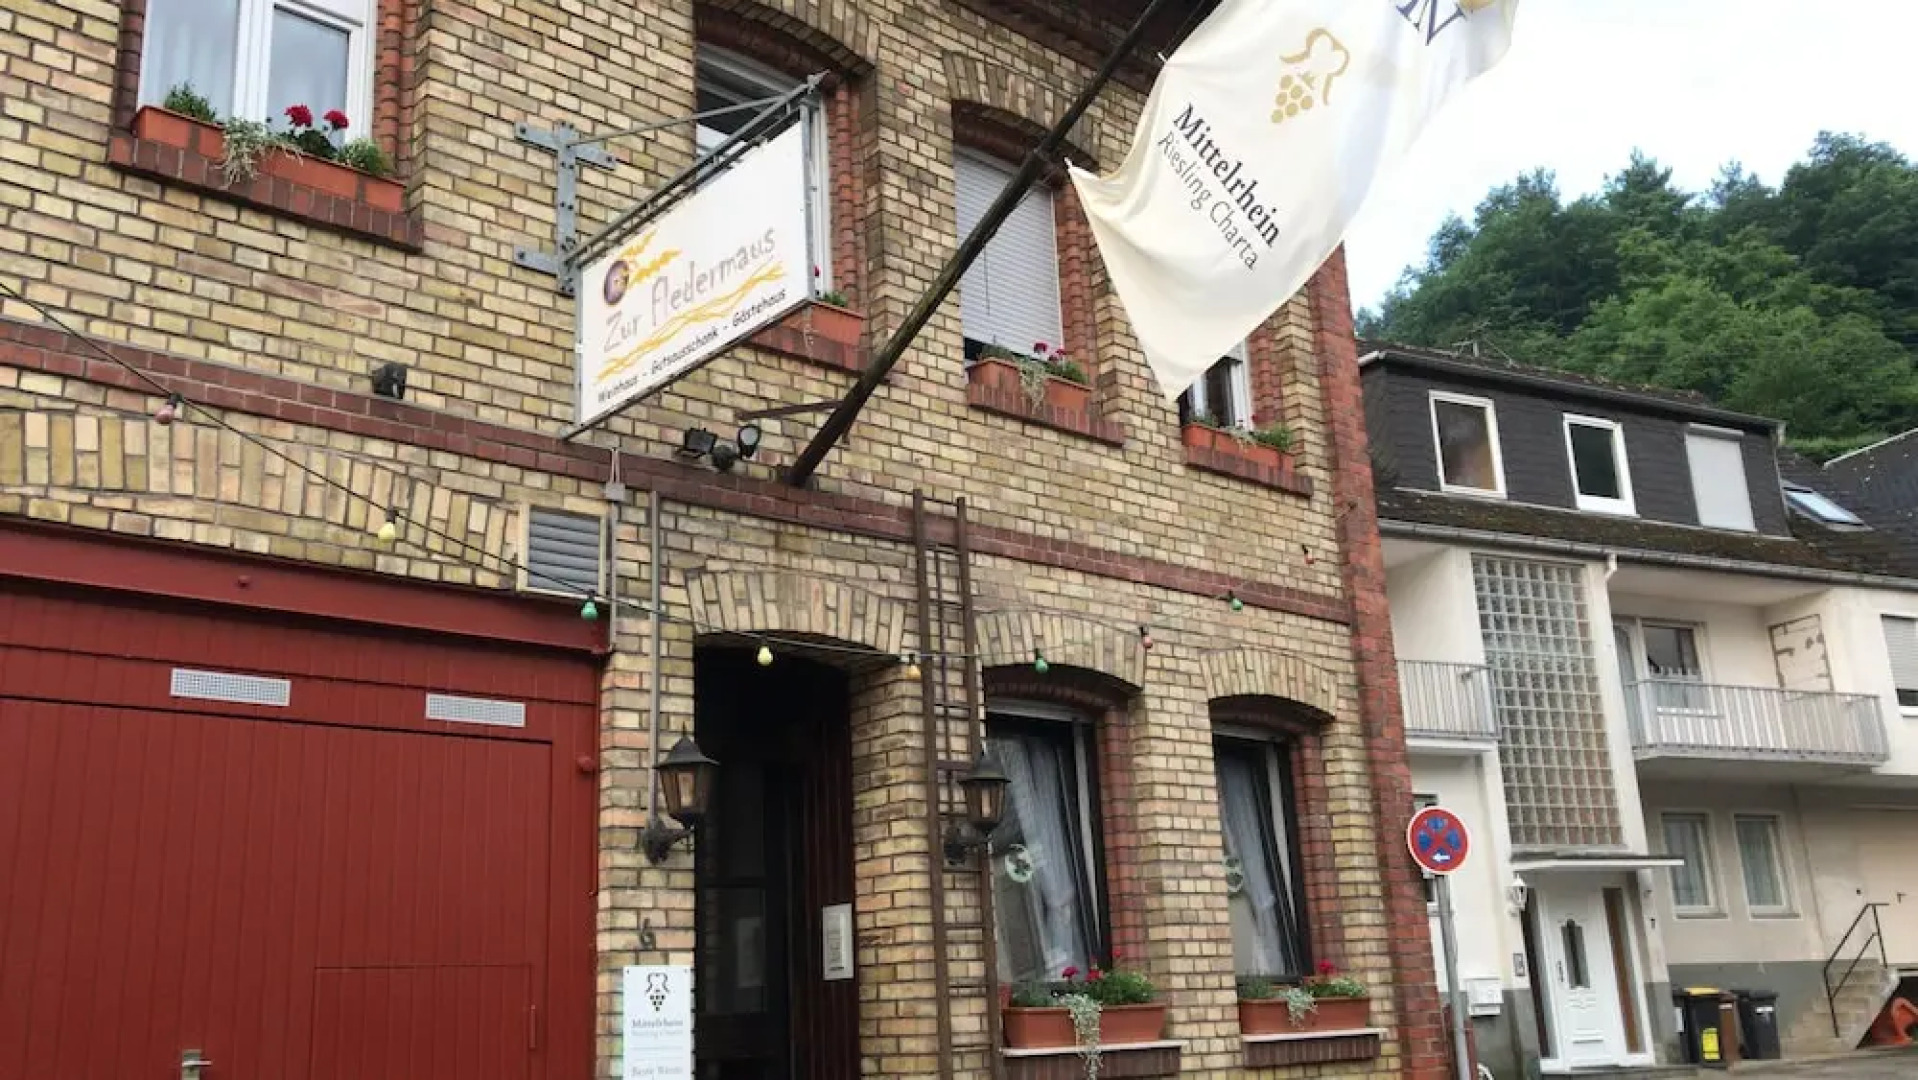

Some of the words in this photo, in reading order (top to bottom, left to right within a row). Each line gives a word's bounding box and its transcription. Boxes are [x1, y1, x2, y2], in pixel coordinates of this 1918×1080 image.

[1157, 130, 1212, 210] Riesling
[1210, 200, 1259, 270] Charta
[1173, 102, 1280, 248] Mittelrhein
[603, 310, 643, 353] Zur
[597, 375, 638, 402] Weinhaus
